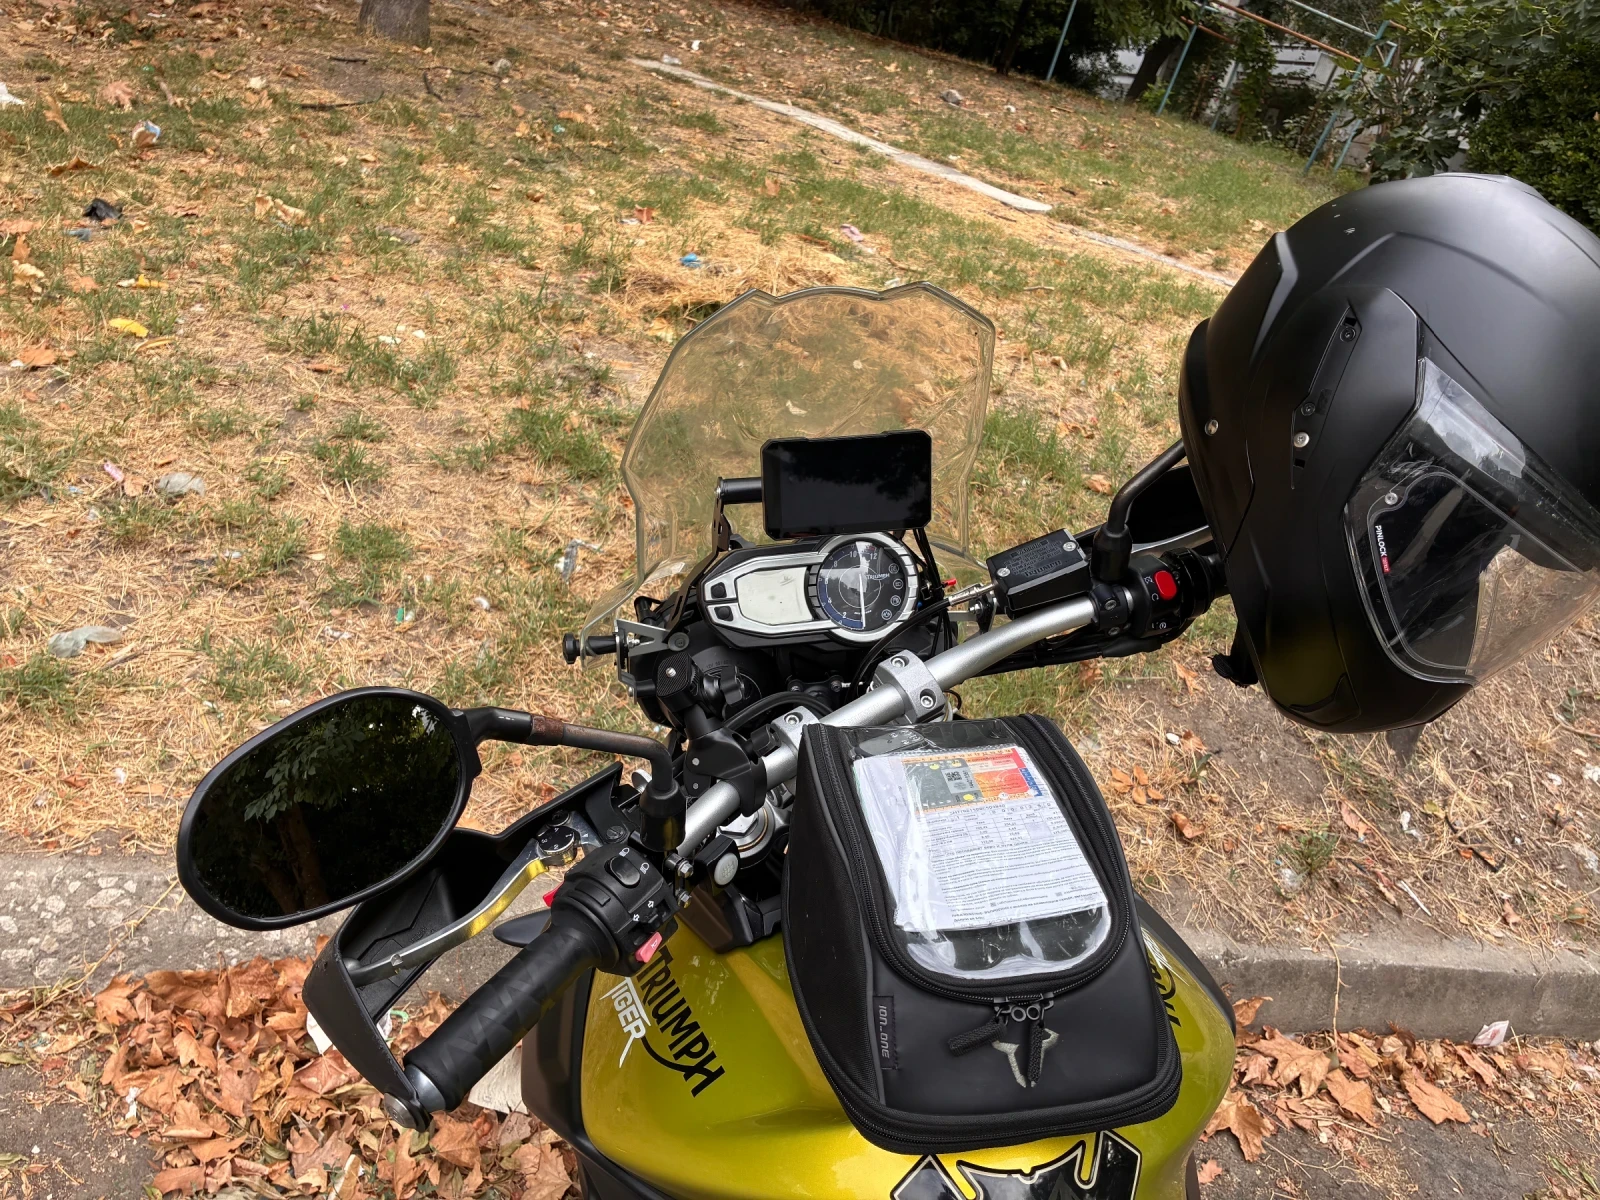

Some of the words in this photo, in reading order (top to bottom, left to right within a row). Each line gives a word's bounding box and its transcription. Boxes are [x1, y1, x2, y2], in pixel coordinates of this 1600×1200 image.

[870, 552, 878, 560] 12
[1375, 525, 1388, 557] PINLOCK
[842, 611, 847, 619] 2
[599, 977, 652, 1069] TIGER
[636, 945, 726, 1098] TRIUMPH
